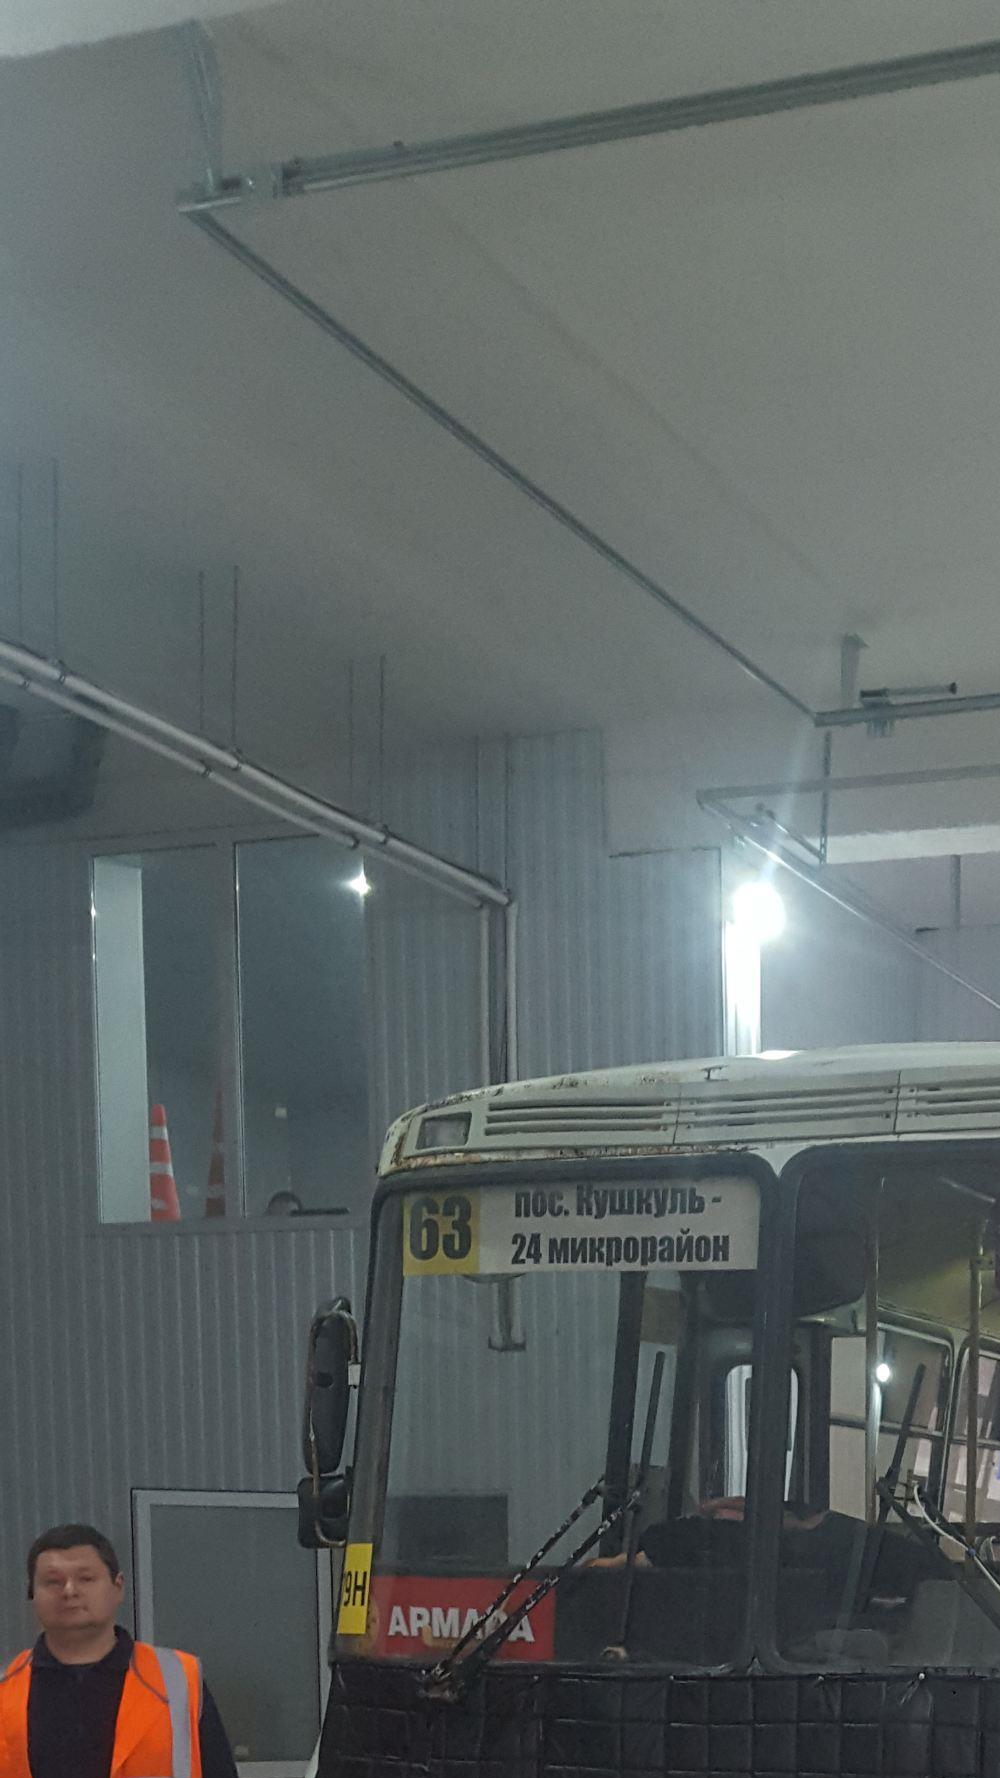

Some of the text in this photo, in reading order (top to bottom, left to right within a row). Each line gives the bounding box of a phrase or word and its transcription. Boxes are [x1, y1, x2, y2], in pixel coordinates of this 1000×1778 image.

[514, 1189, 570, 1218] пос.
[576, 1184, 706, 1219] Кушкуль
[409, 1195, 472, 1261] 63
[511, 1227, 730, 1267] 24 микрорайон
